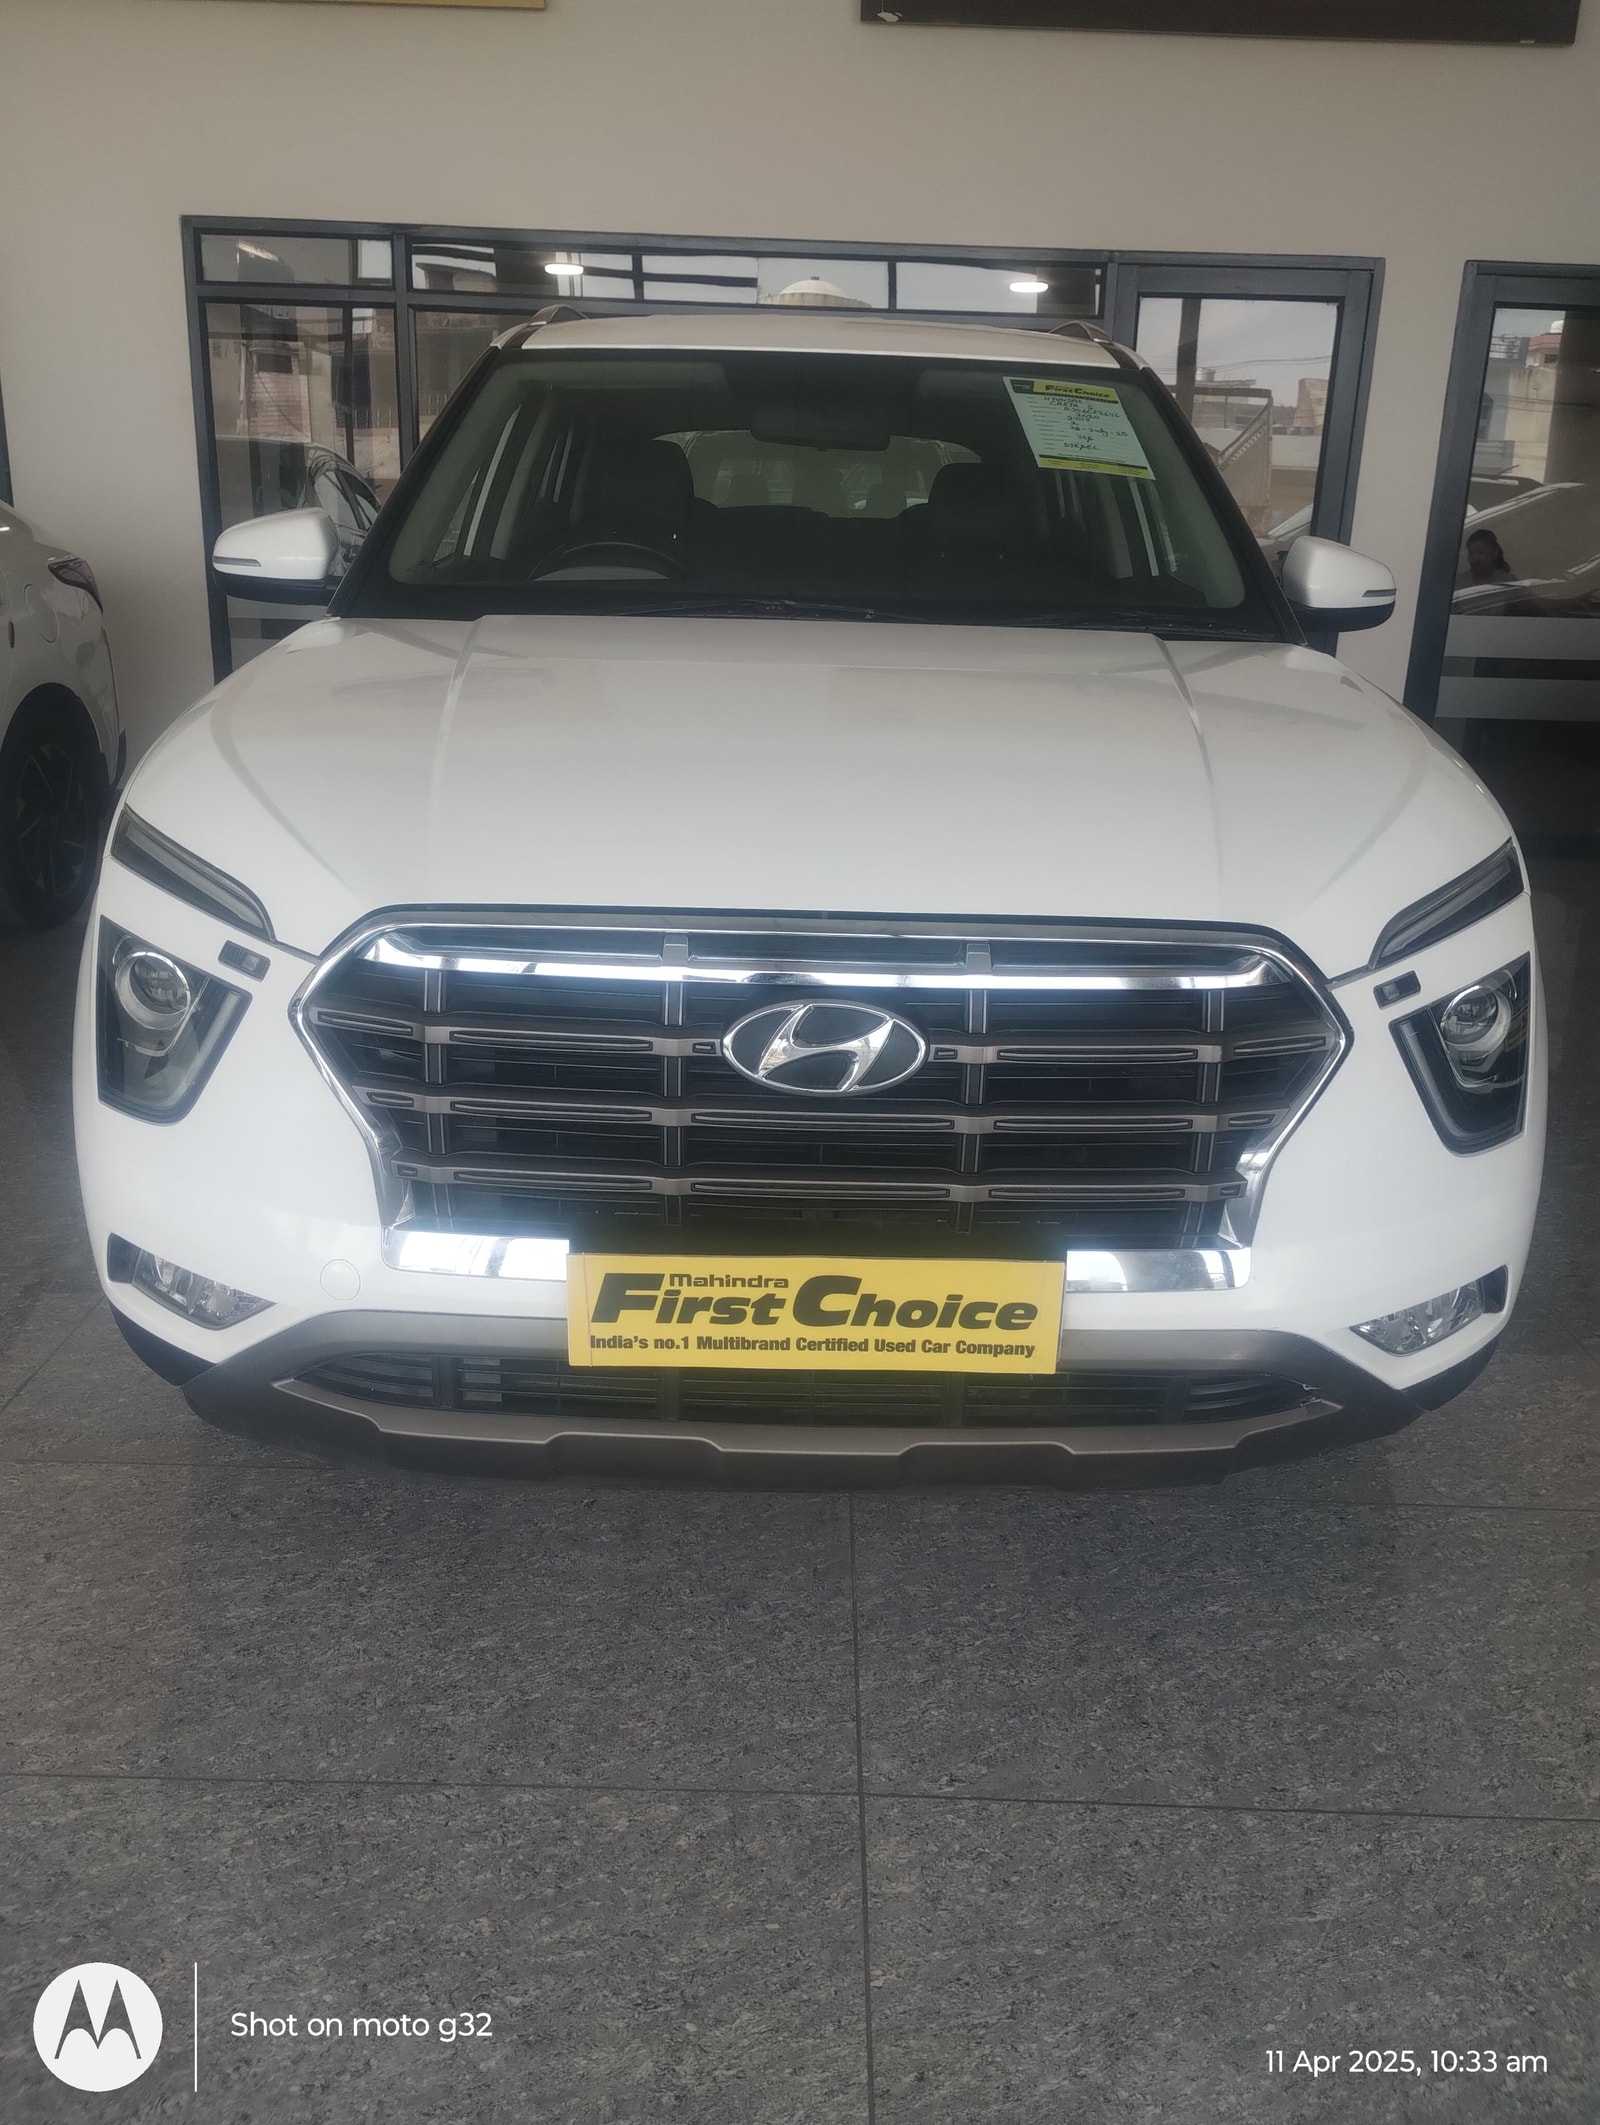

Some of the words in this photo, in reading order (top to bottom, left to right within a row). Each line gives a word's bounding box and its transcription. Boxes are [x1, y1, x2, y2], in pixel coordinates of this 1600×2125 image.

[1045, 384, 1073, 393] First
[1073, 387, 1110, 398] Choice
[669, 1273, 789, 1289] Mahindra
[591, 1273, 788, 1325] First
[792, 1275, 1038, 1330] Choice
[590, 1334, 649, 1350] India's
[653, 1335, 690, 1350] no.1
[696, 1336, 791, 1351] Multibrand
[795, 1337, 870, 1353] Certified
[874, 1339, 917, 1354] Used
[920, 1340, 952, 1355] Car
[955, 1341, 1035, 1358] Company
